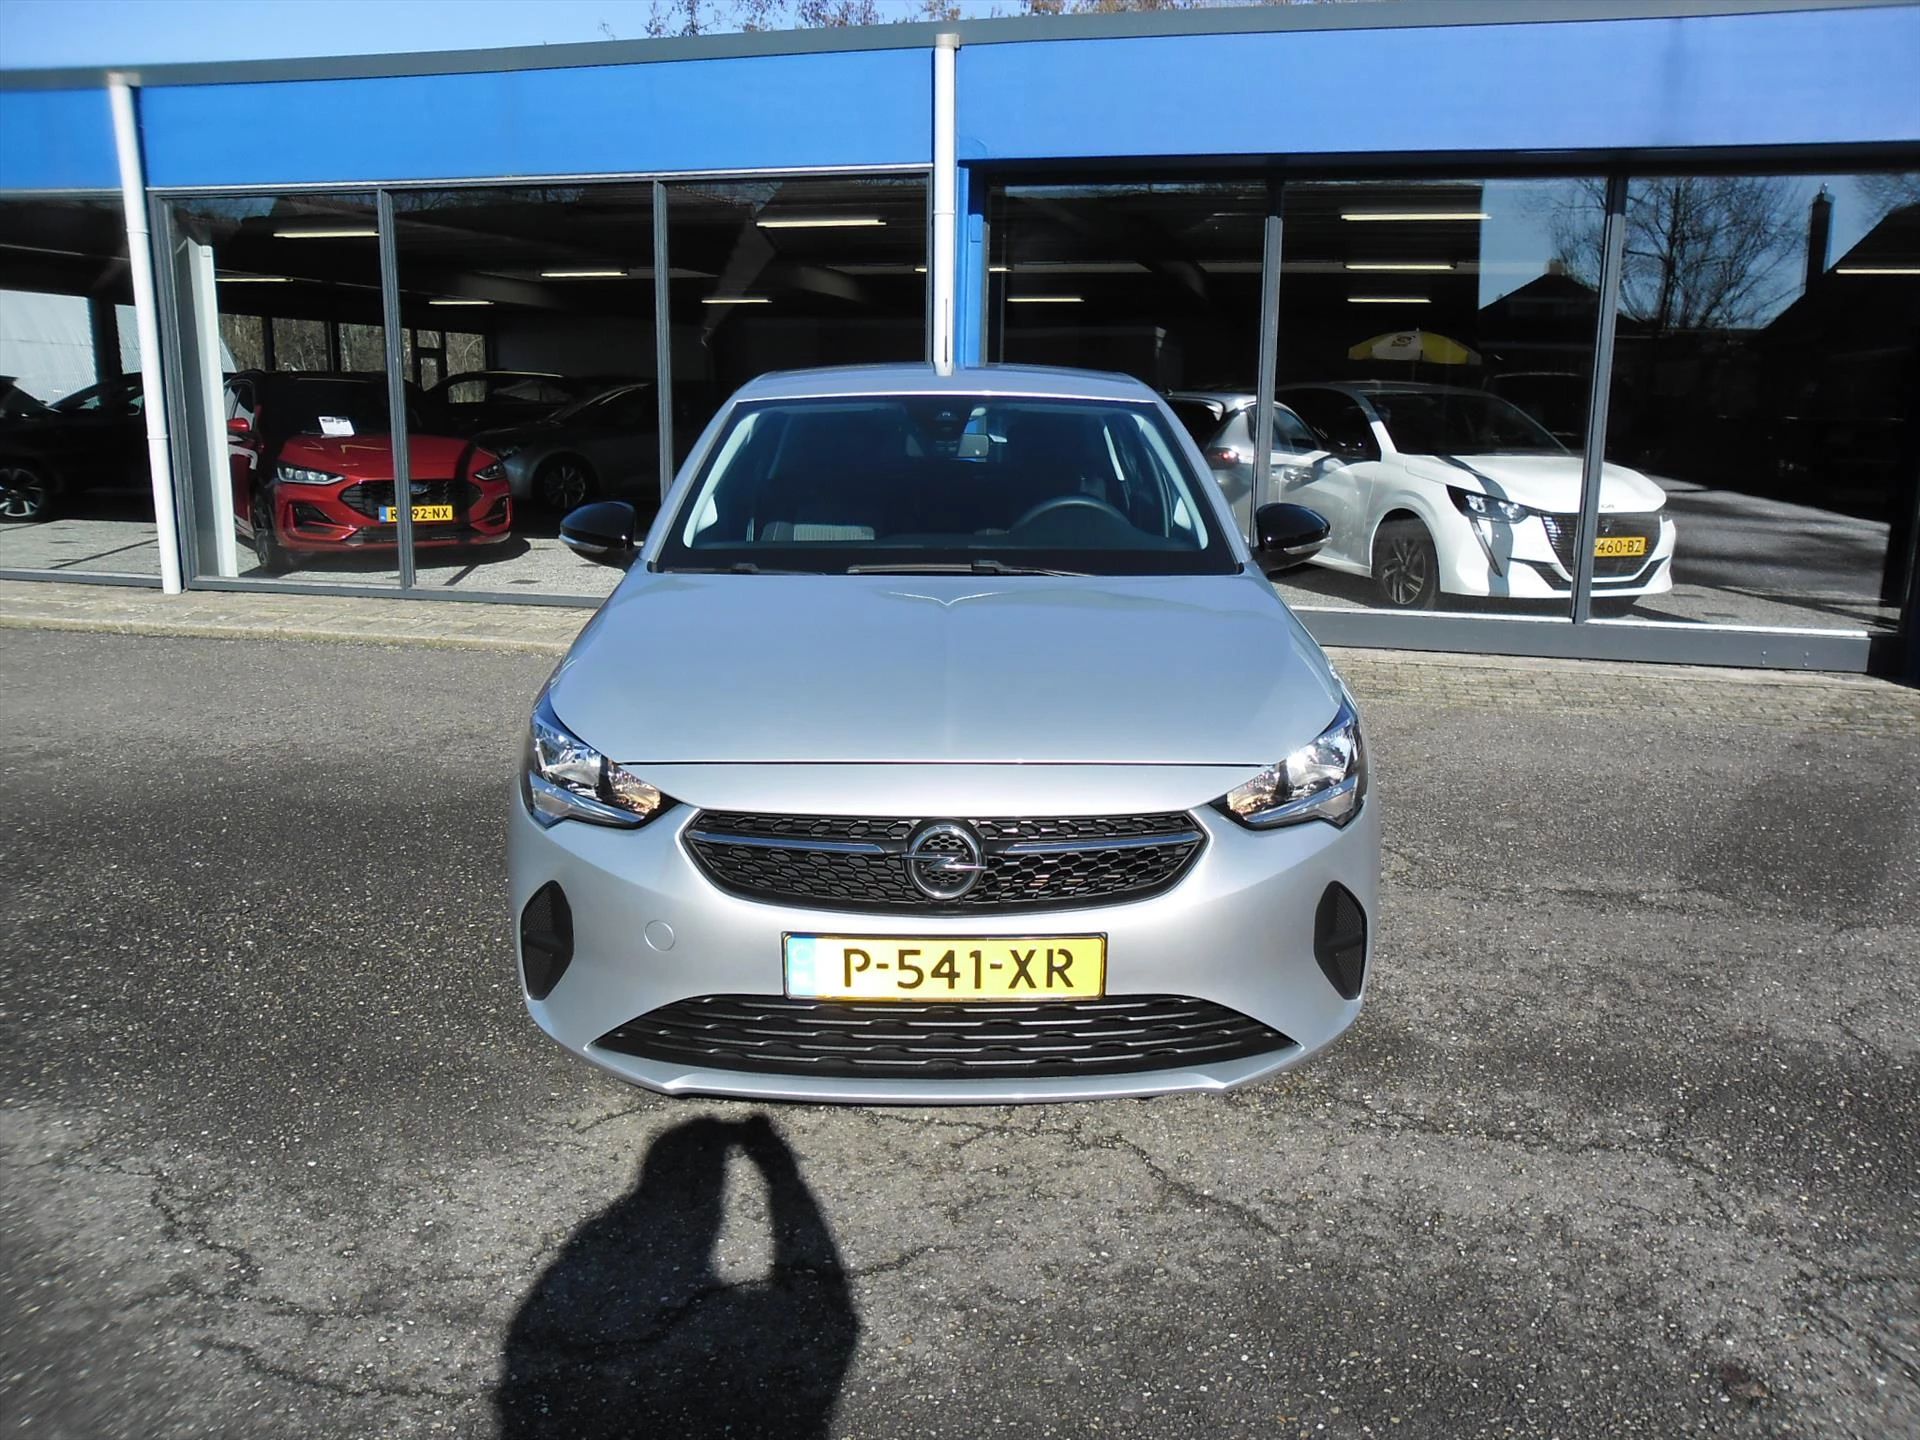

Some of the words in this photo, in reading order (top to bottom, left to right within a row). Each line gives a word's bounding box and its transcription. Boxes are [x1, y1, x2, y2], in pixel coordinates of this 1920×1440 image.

[390, 507, 449, 520] R92-NX
[1595, 540, 1642, 554] -460-BZ
[843, 948, 1074, 989] P-541-XR
